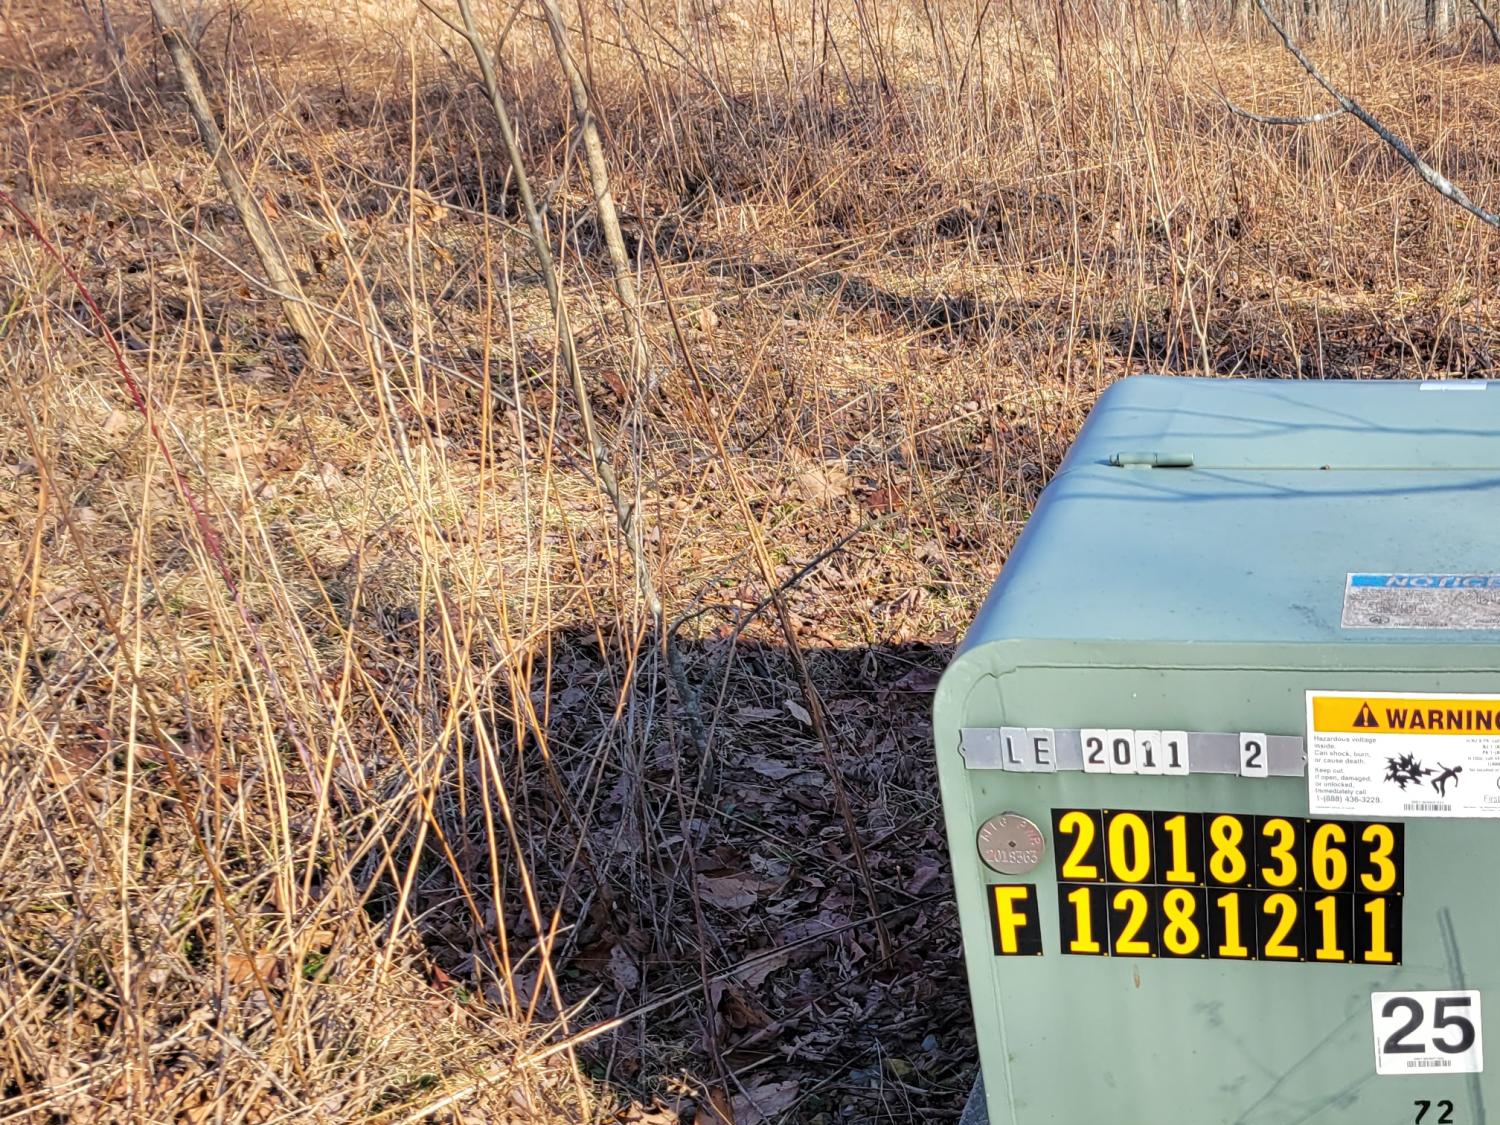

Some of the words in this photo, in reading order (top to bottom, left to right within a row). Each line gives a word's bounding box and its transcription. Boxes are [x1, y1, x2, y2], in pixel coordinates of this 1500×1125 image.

[1006, 736, 1050, 765] LE
[1085, 736, 1183, 768] 2011
[1243, 741, 1263, 769] 2
[1313, 735, 1350, 743] Hazardous
[1314, 767, 1331, 775] Keep
[1057, 810, 1398, 892] 2018363
[994, 886, 1029, 954] F
[1067, 886, 1395, 962] 1281211
[1381, 996, 1476, 1054] 25
[1413, 1099, 1454, 1125] 72
